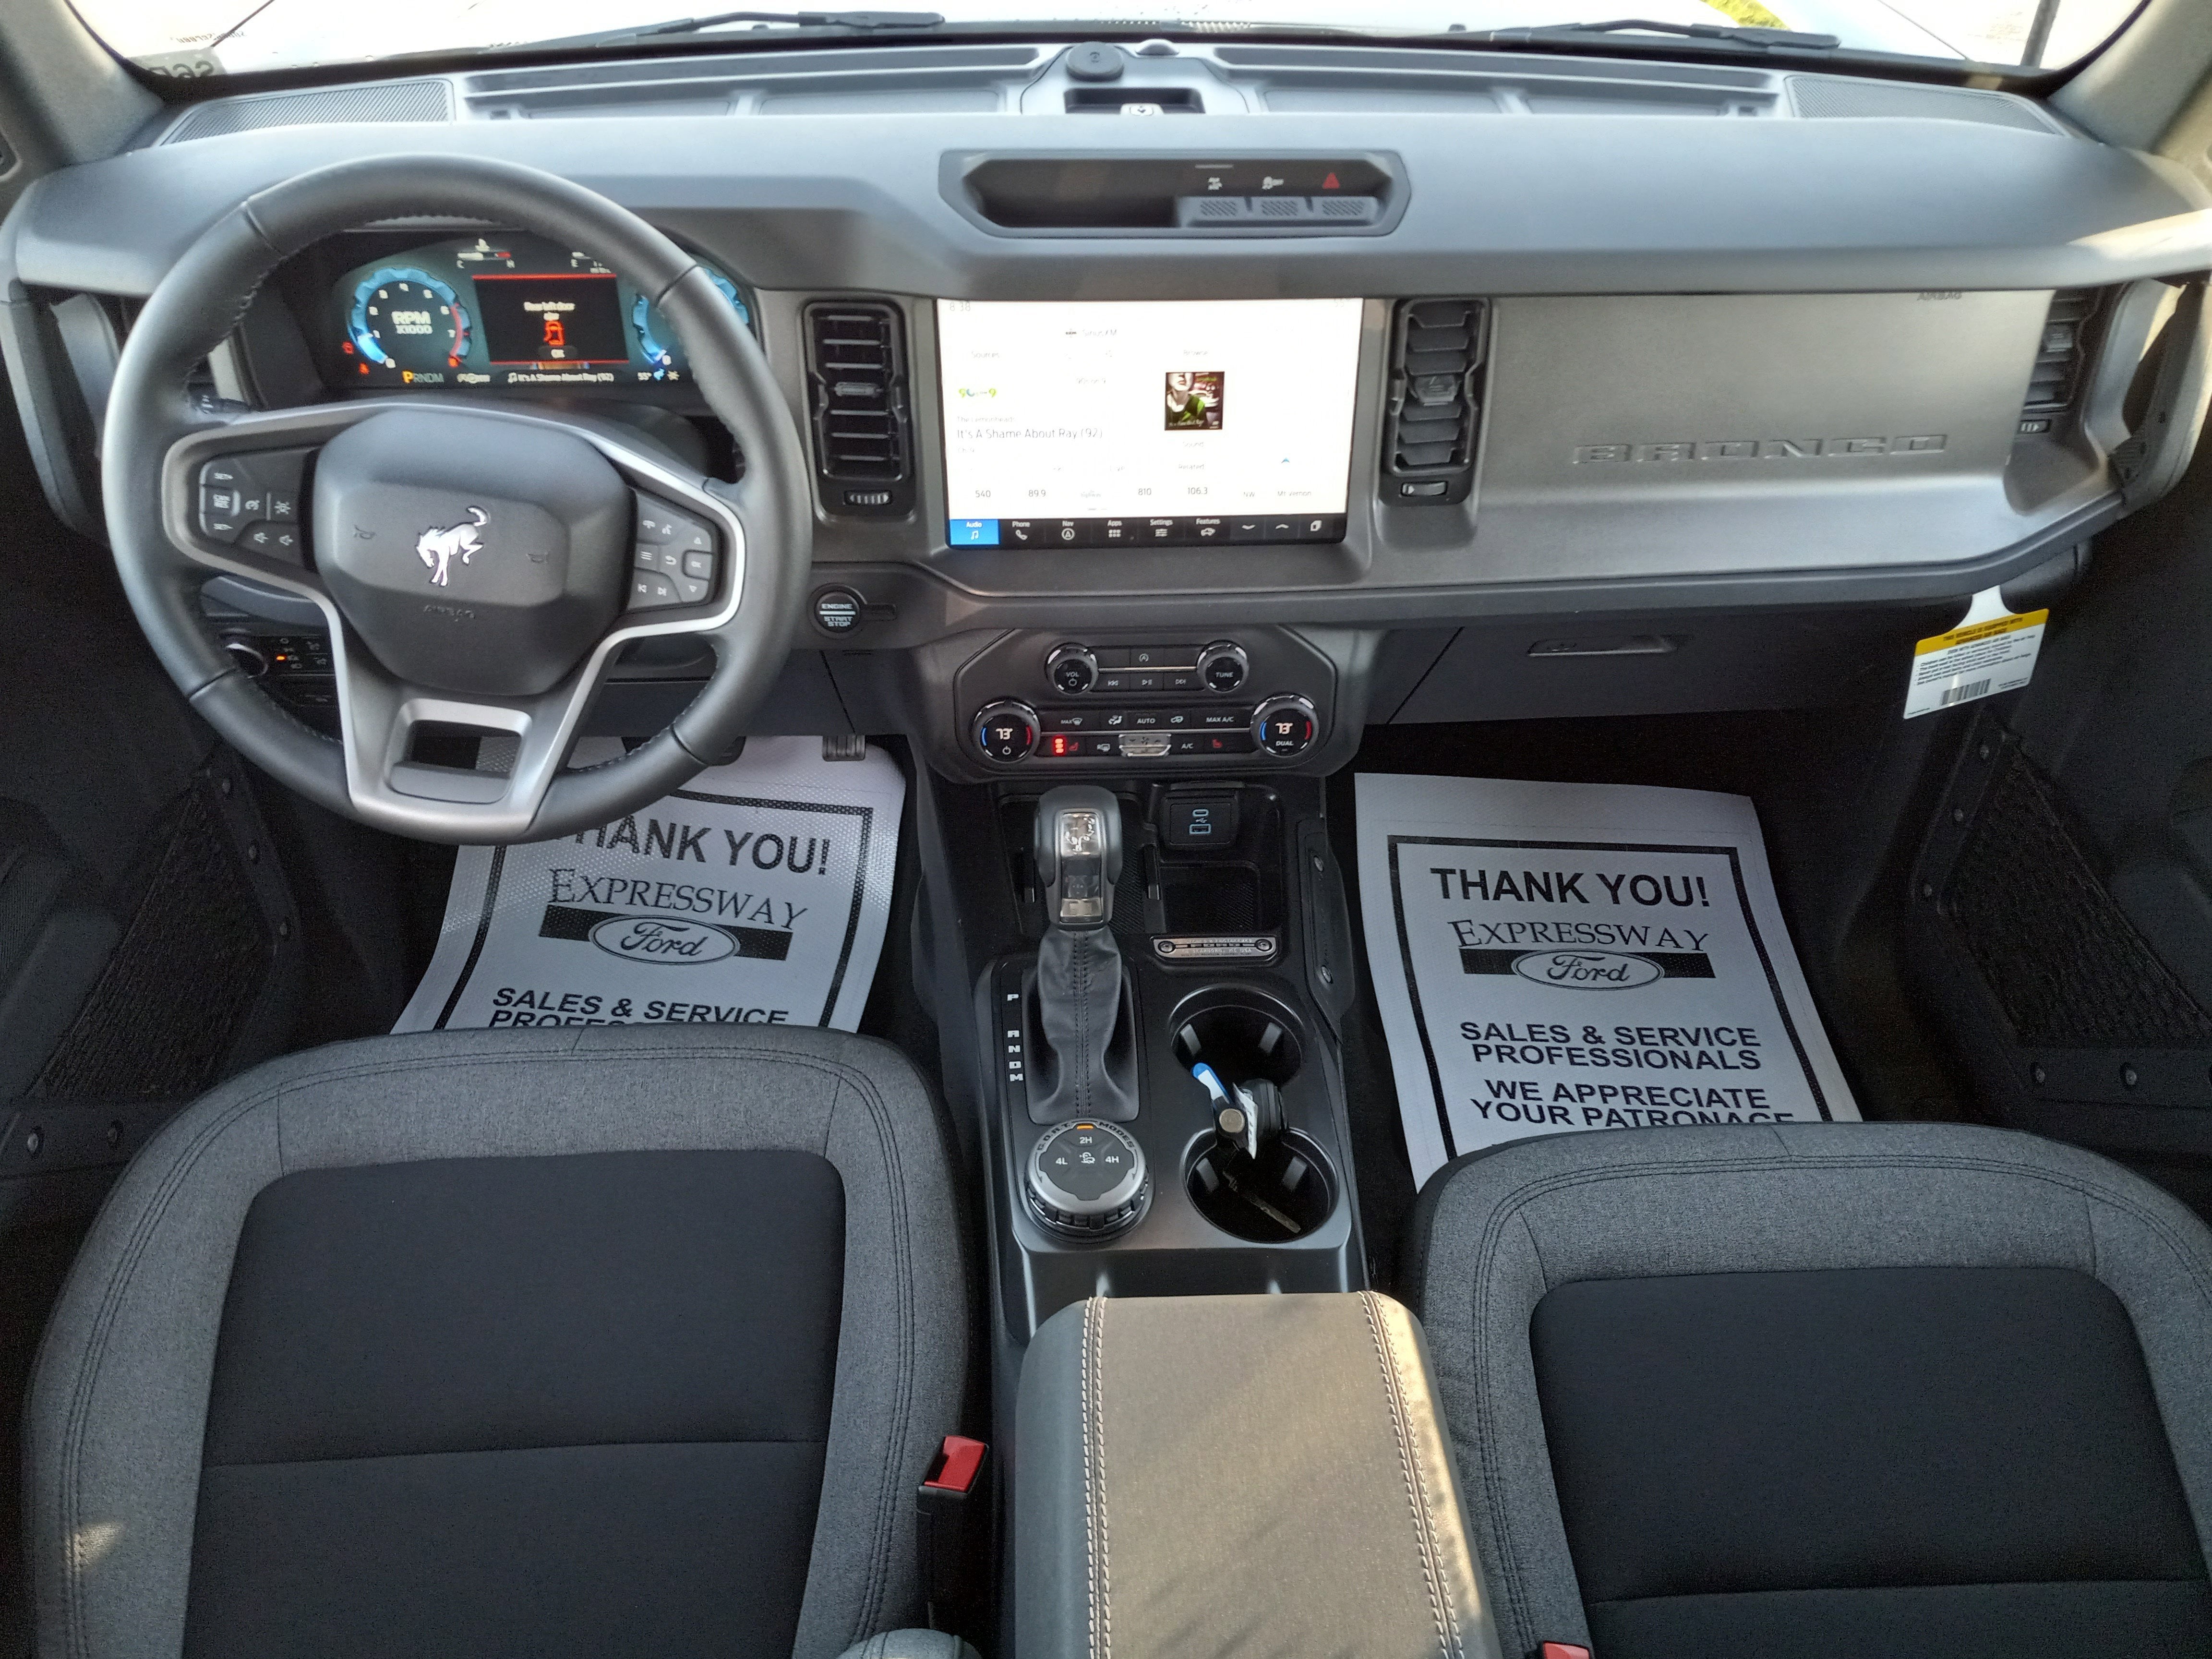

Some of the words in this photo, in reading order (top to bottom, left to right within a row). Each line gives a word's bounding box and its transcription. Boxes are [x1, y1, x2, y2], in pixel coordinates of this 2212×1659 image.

[391, 311, 431, 324] RPM
[975, 429, 983, 438] A
[986, 428, 1022, 439] Shame
[1024, 428, 1055, 439] About
[1058, 428, 1077, 441] Ray
[1572, 434, 1947, 464] BRONCO
[975, 490, 991, 498] 540
[1187, 487, 1208, 495] 106.3
[575, 815, 711, 863] HANK
[724, 829, 830, 876] YOU!
[547, 867, 808, 930] EXPRESSWAY
[1430, 866, 1590, 905] THANK
[1595, 873, 1711, 907] YOU!
[620, 922, 709, 957] Ford
[1447, 918, 1709, 952] EXPRESSWAY
[1546, 954, 1631, 983] Ford
[493, 987, 603, 1014] SALES
[610, 998, 633, 1018] &
[644, 1000, 789, 1023] SERVICE
[1459, 1021, 1571, 1045] SALES
[1582, 1024, 1606, 1045] &
[1613, 1025, 1762, 1047] SERVICE
[1009, 1061, 1021, 1069] D
[1471, 1044, 1762, 1070] PROFESSIONALS
[1010, 1073, 1023, 1082] M
[1483, 1079, 1543, 1101] WE
[1552, 1082, 1770, 1109] APPRECIATE
[1470, 1098, 1575, 1125] YOUR
[1079, 1136, 1093, 1144] 2H
[1099, 1122, 1135, 1148] MODES
[1105, 1155, 1120, 1164] 4H
